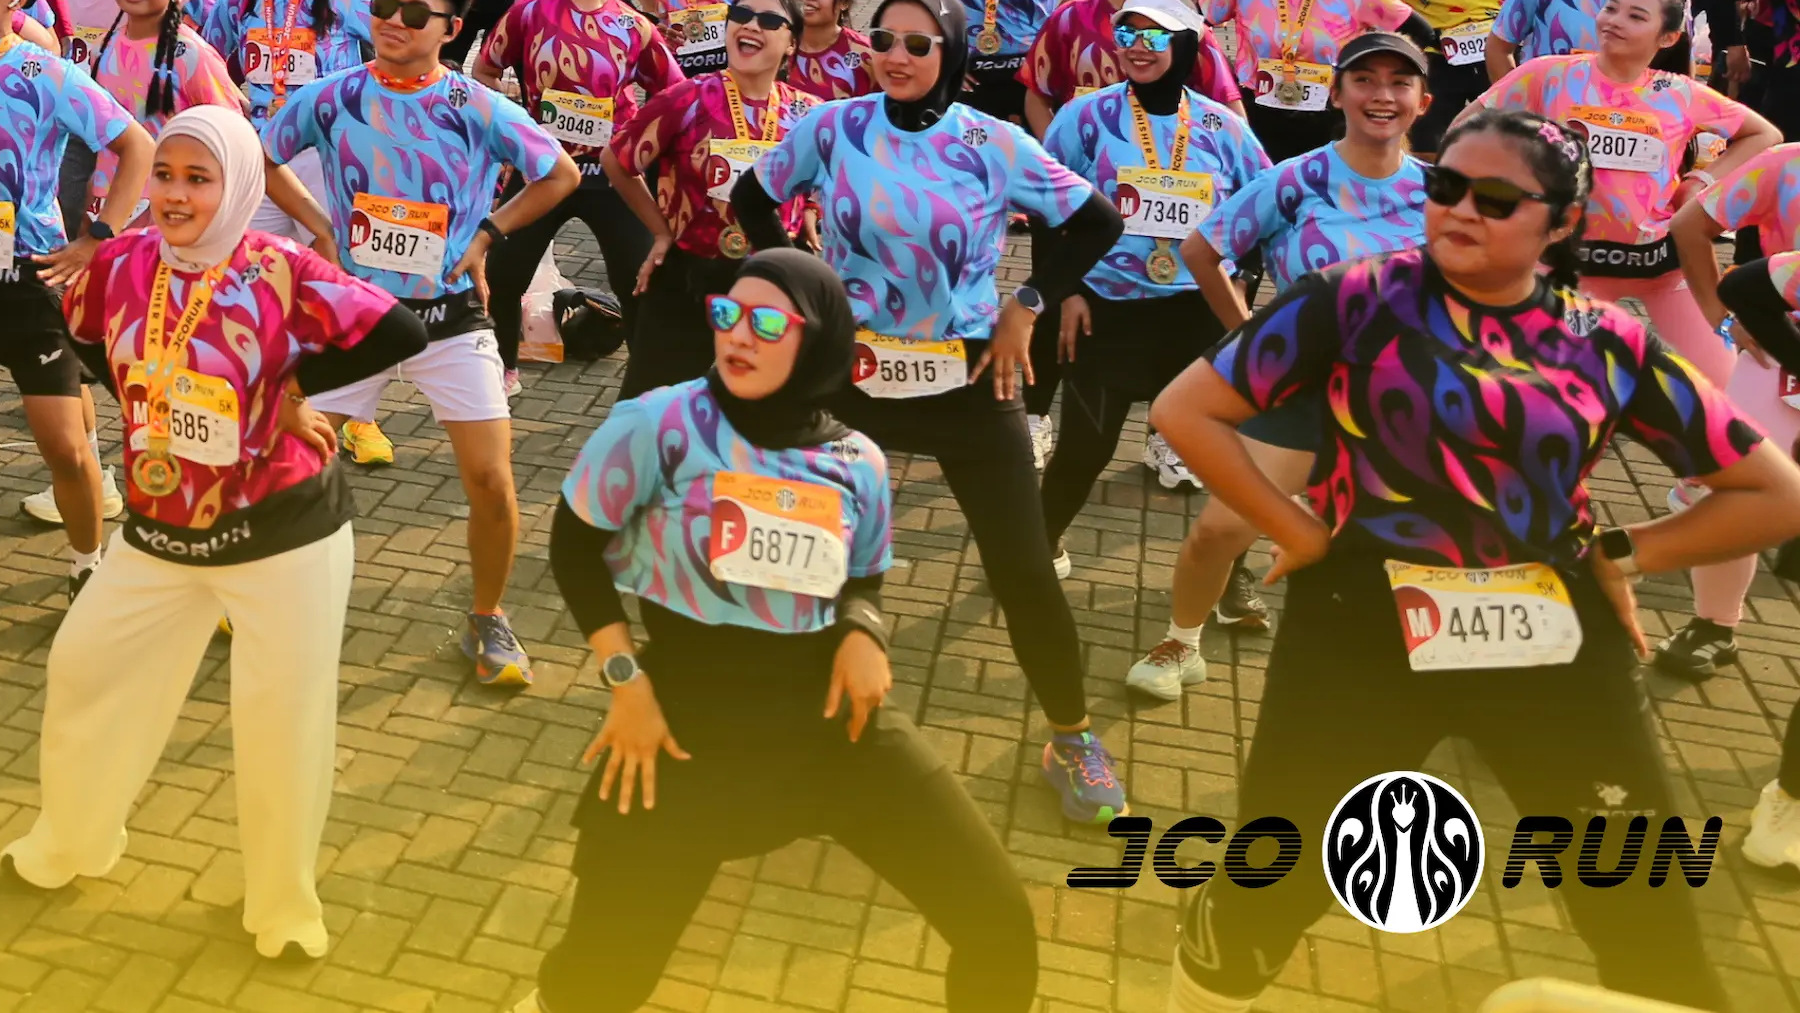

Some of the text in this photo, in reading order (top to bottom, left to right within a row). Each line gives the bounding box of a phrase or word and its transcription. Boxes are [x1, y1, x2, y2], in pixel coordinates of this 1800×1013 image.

[284, 4, 297, 38] JCORUN
[84, 32, 97, 40] JCO
[75, 48, 83, 62] F
[1444, 42, 1457, 58] M
[249, 52, 296, 73] F 78
[1301, 68, 1320, 76] RUN
[1258, 78, 1269, 93] M
[554, 96, 604, 111] JCO RUN
[728, 88, 746, 138] FINISHER
[1584, 112, 1646, 125] JCO RUN
[542, 110, 594, 137] M 3048
[1132, 104, 1153, 155] FINISHER
[725, 147, 746, 157] JCO
[1591, 134, 1638, 158] 2807
[713, 166, 724, 184] F
[1136, 176, 1198, 188] JCO RUN
[1199, 190, 1210, 201] 5K
[367, 203, 430, 220] JCO RUN
[1120, 196, 1189, 224] M 7346
[0, 219, 11, 230] 5K
[428, 220, 444, 232] 10K
[352, 223, 419, 258] M 5487
[173, 297, 205, 353] JCORUN
[149, 329, 160, 346] 5K
[946, 343, 960, 354] 5K
[859, 358, 937, 383] F 5815
[218, 399, 233, 413] 5K
[133, 401, 210, 444] M 585
[741, 488, 827, 509] JCO RUN
[135, 519, 251, 558] JCORUN
[720, 520, 816, 569] F 6877
[1536, 581, 1557, 597] 5K
[1405, 605, 1533, 644] M 4473
